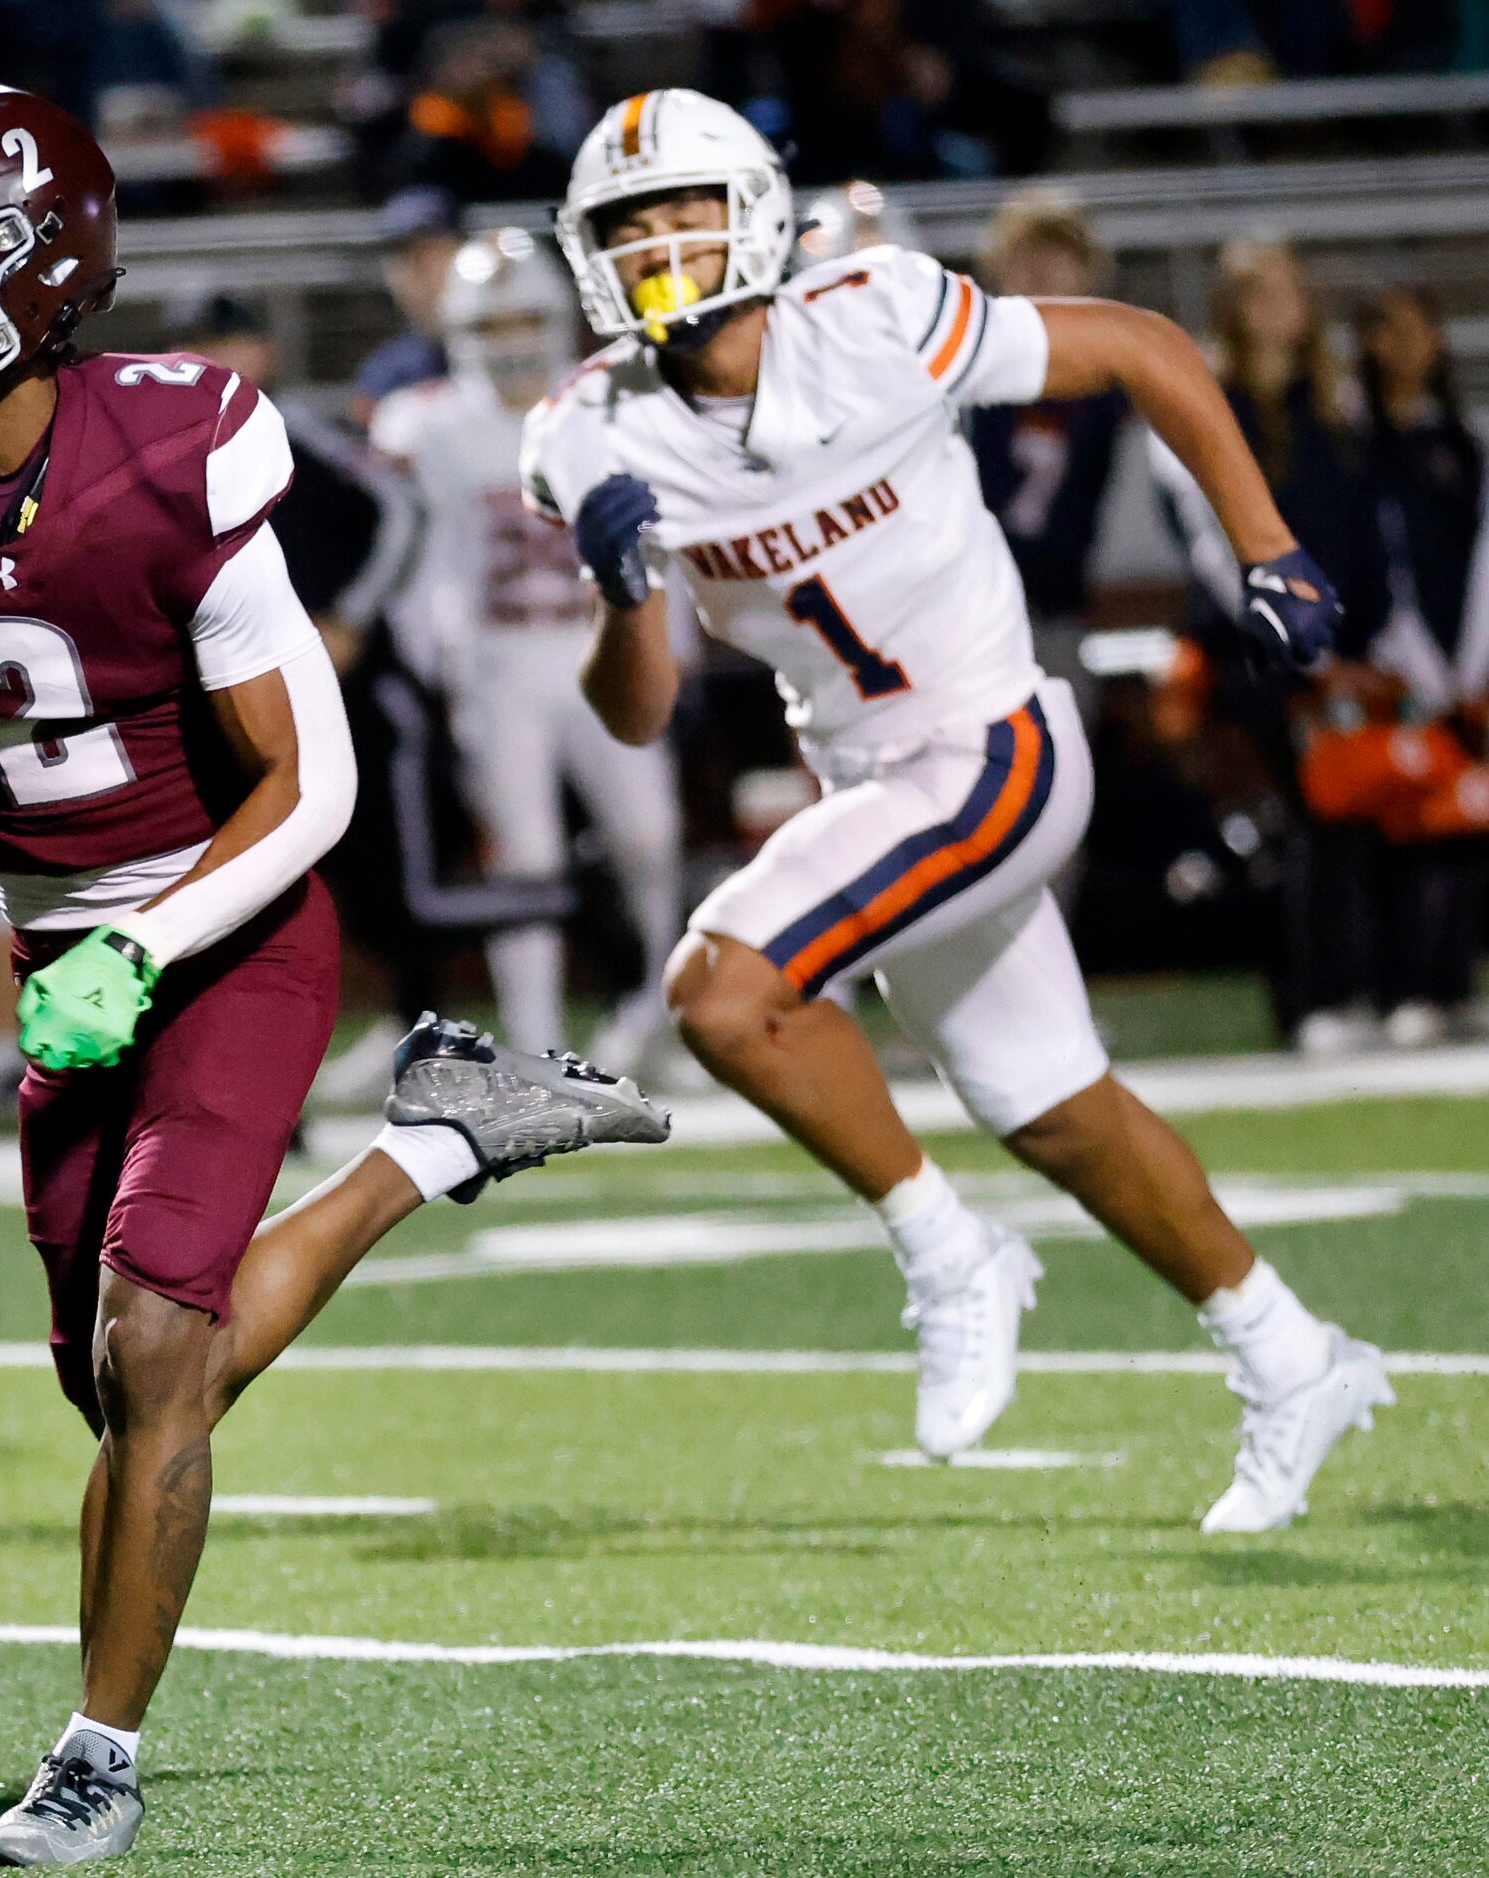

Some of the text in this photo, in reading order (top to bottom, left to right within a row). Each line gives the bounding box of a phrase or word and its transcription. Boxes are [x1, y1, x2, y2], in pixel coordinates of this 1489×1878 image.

[1, 127, 54, 194] 2
[114, 360, 206, 387] 2
[785, 571, 914, 702] 1
